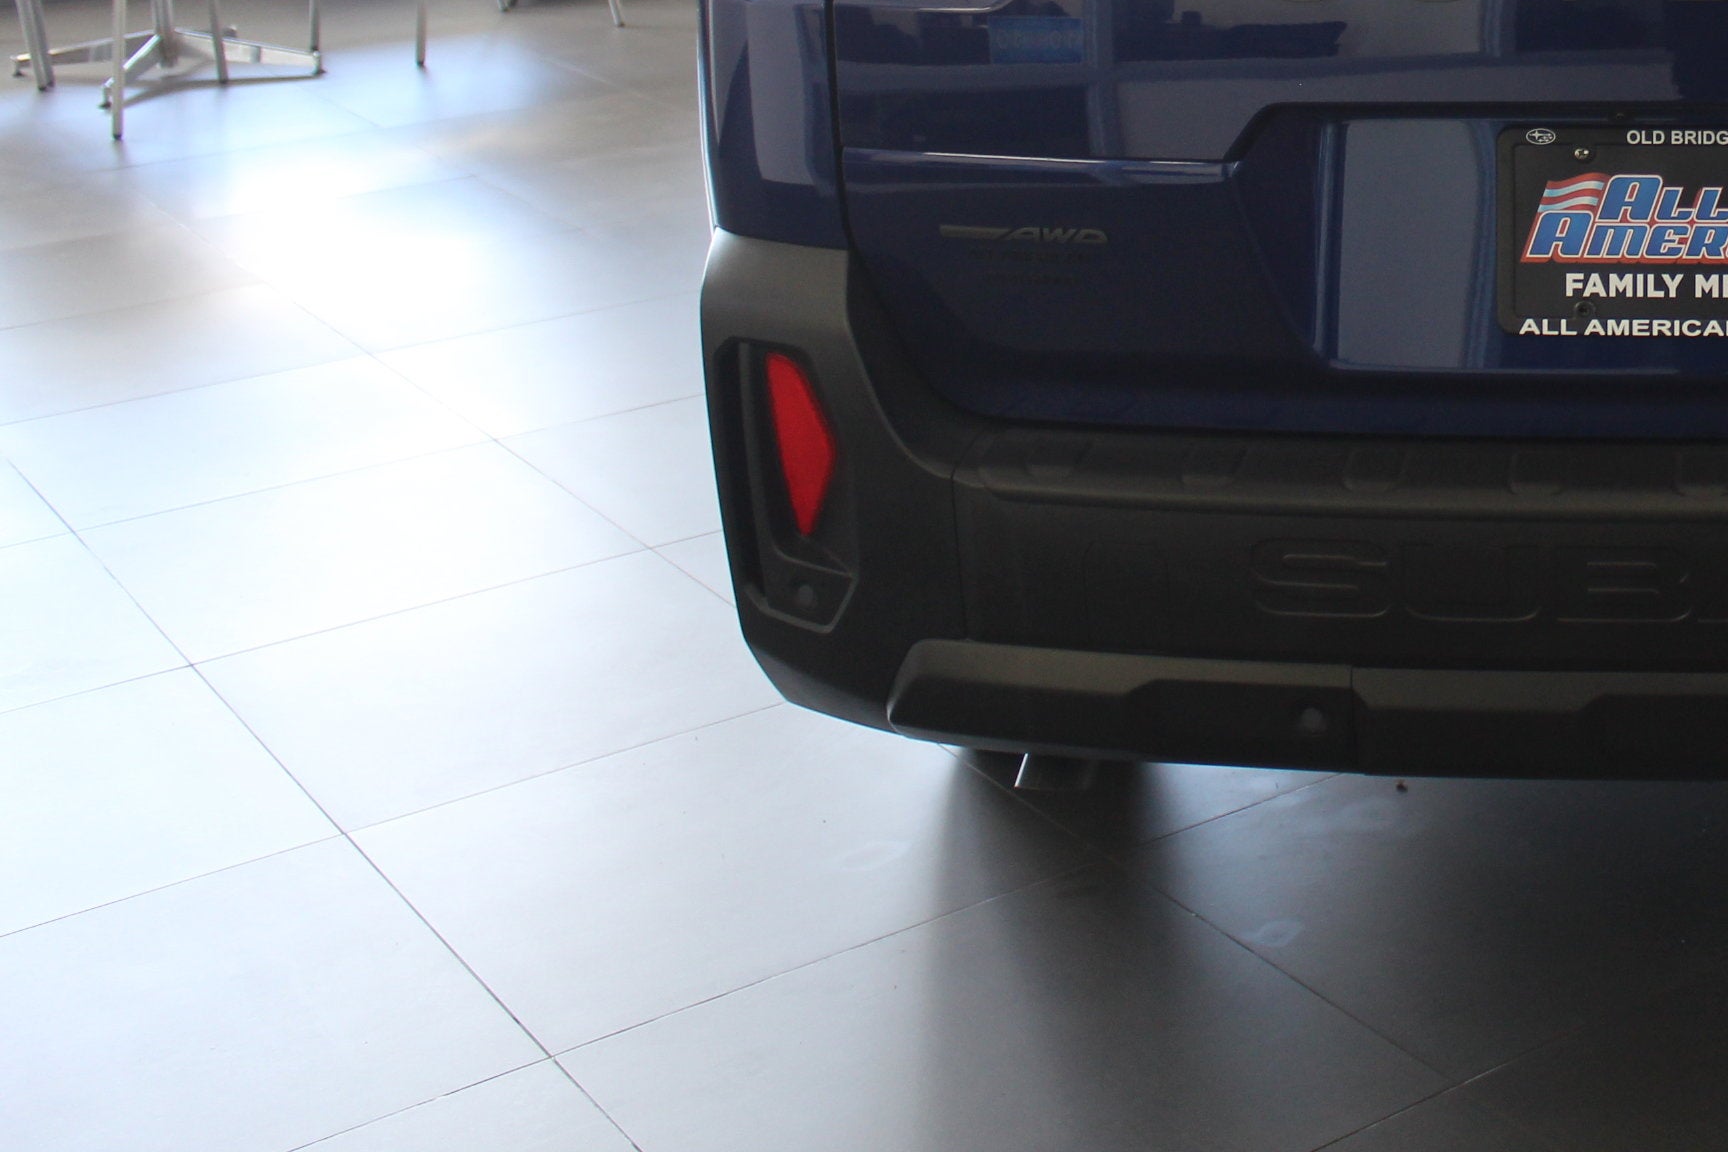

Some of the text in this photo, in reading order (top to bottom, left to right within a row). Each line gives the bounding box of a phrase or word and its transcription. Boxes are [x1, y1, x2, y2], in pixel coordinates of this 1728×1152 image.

[1626, 130, 1667, 145] OLD
[1006, 226, 1108, 244] AWD
[1565, 273, 1684, 298] FAMILY
[1519, 318, 1578, 336] ALL
